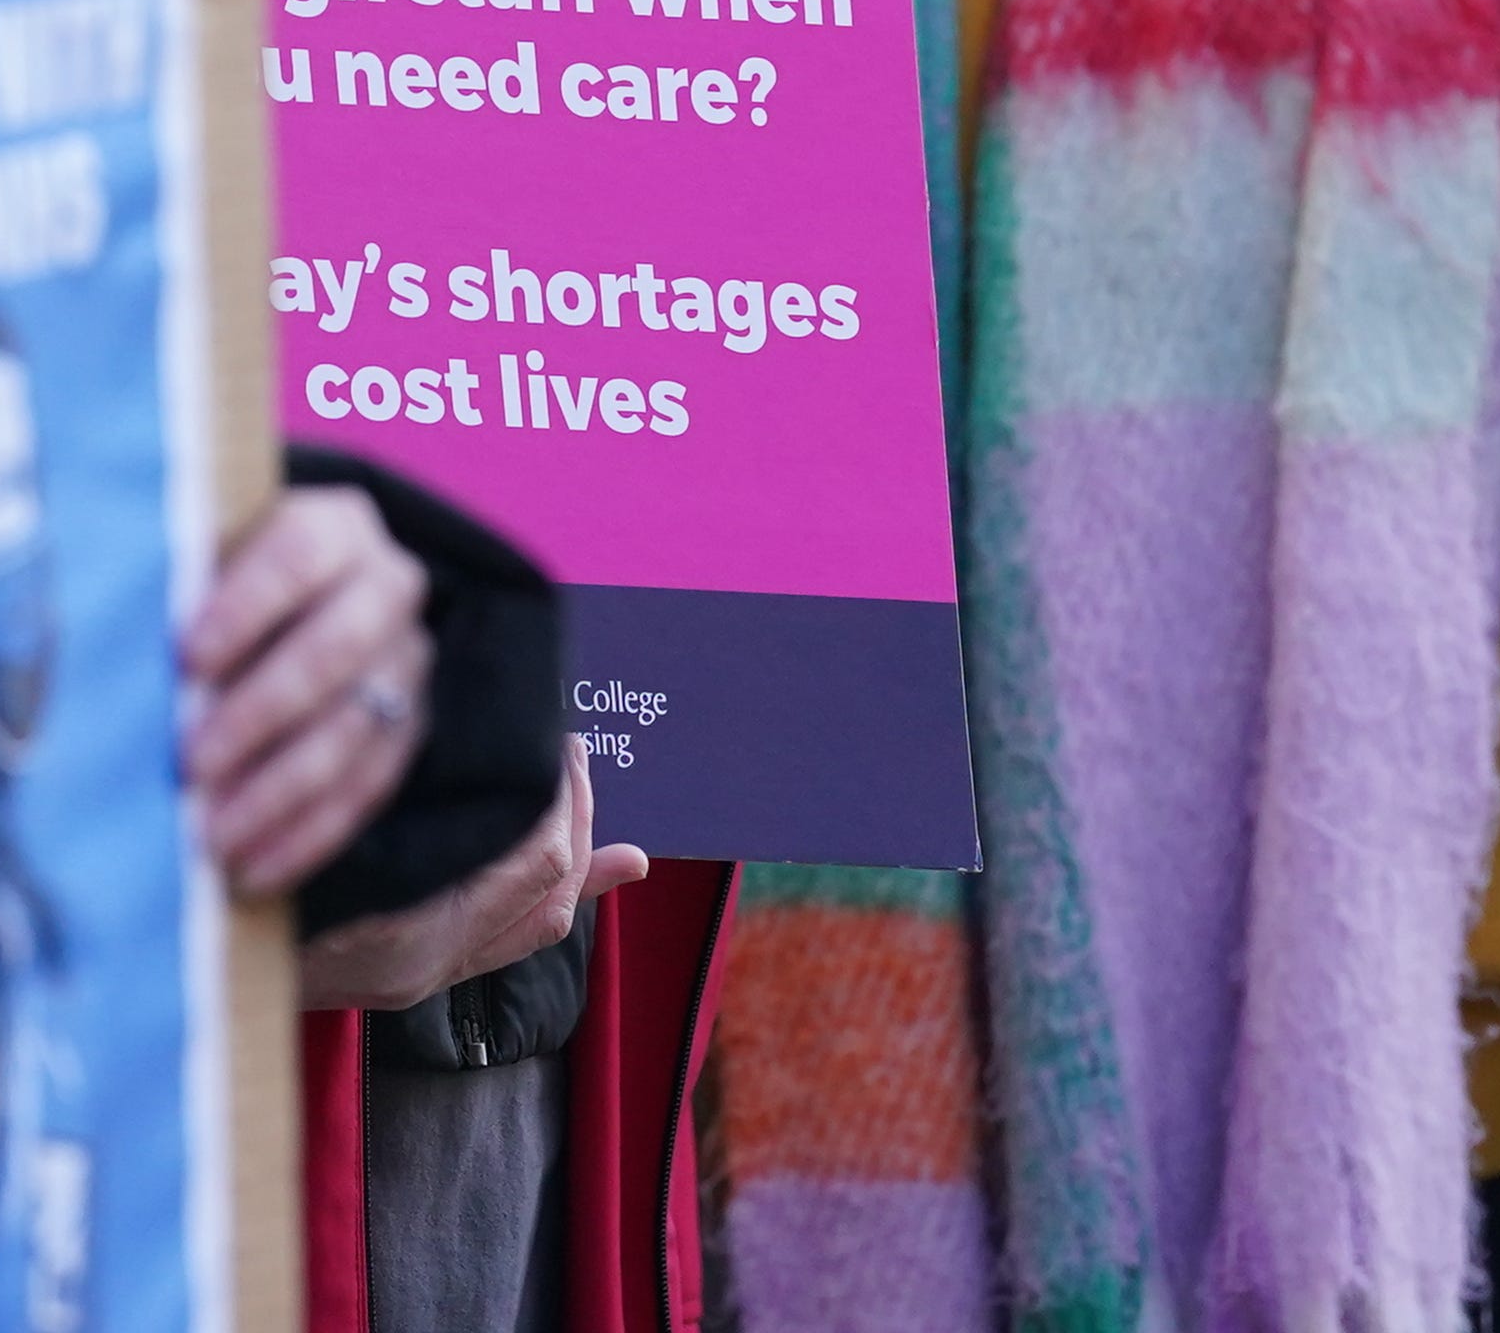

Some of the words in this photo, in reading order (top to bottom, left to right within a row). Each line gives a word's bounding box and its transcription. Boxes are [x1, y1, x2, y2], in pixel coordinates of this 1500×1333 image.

[335, 41, 540, 114] need
[560, 56, 777, 126] care?
[268, 241, 430, 332] ay's
[448, 248, 860, 353] shortages
[305, 358, 483, 425] cost
[499, 349, 689, 436] lives
[573, 680, 668, 726] College
